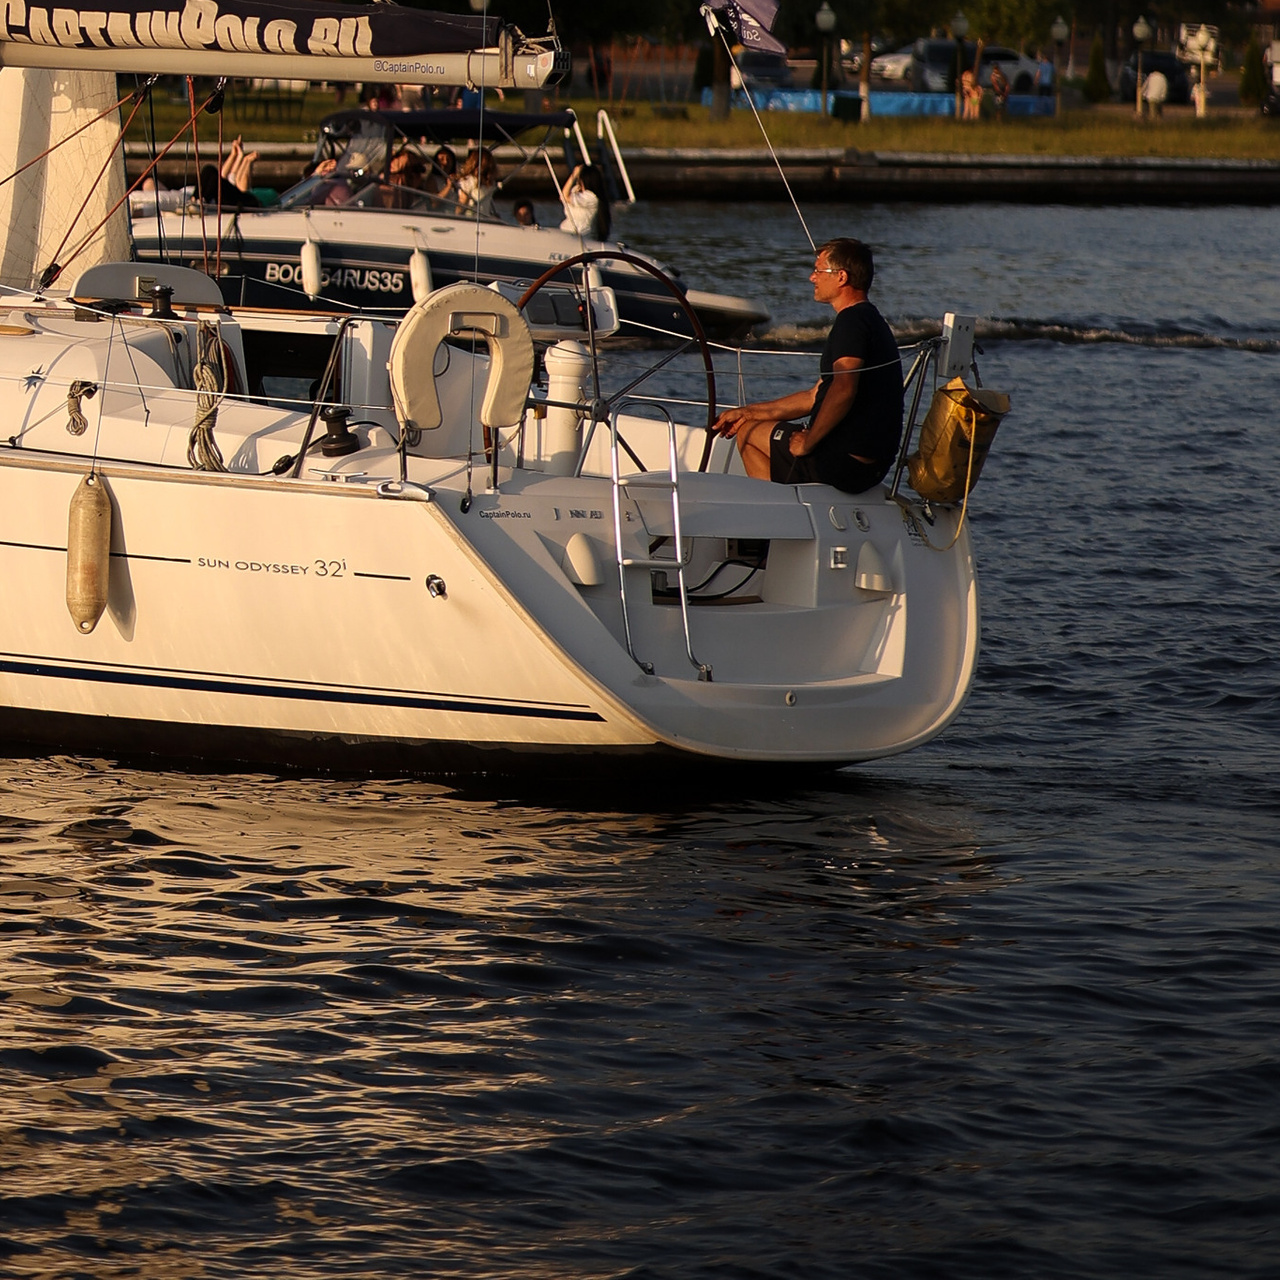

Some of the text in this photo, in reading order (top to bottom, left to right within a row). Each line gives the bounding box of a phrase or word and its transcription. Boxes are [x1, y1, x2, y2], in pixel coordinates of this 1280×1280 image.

[479, 510, 531, 520] CaptainPolo.ru
[198, 557, 230, 569] SUN
[235, 560, 309, 575] ODYSSEY
